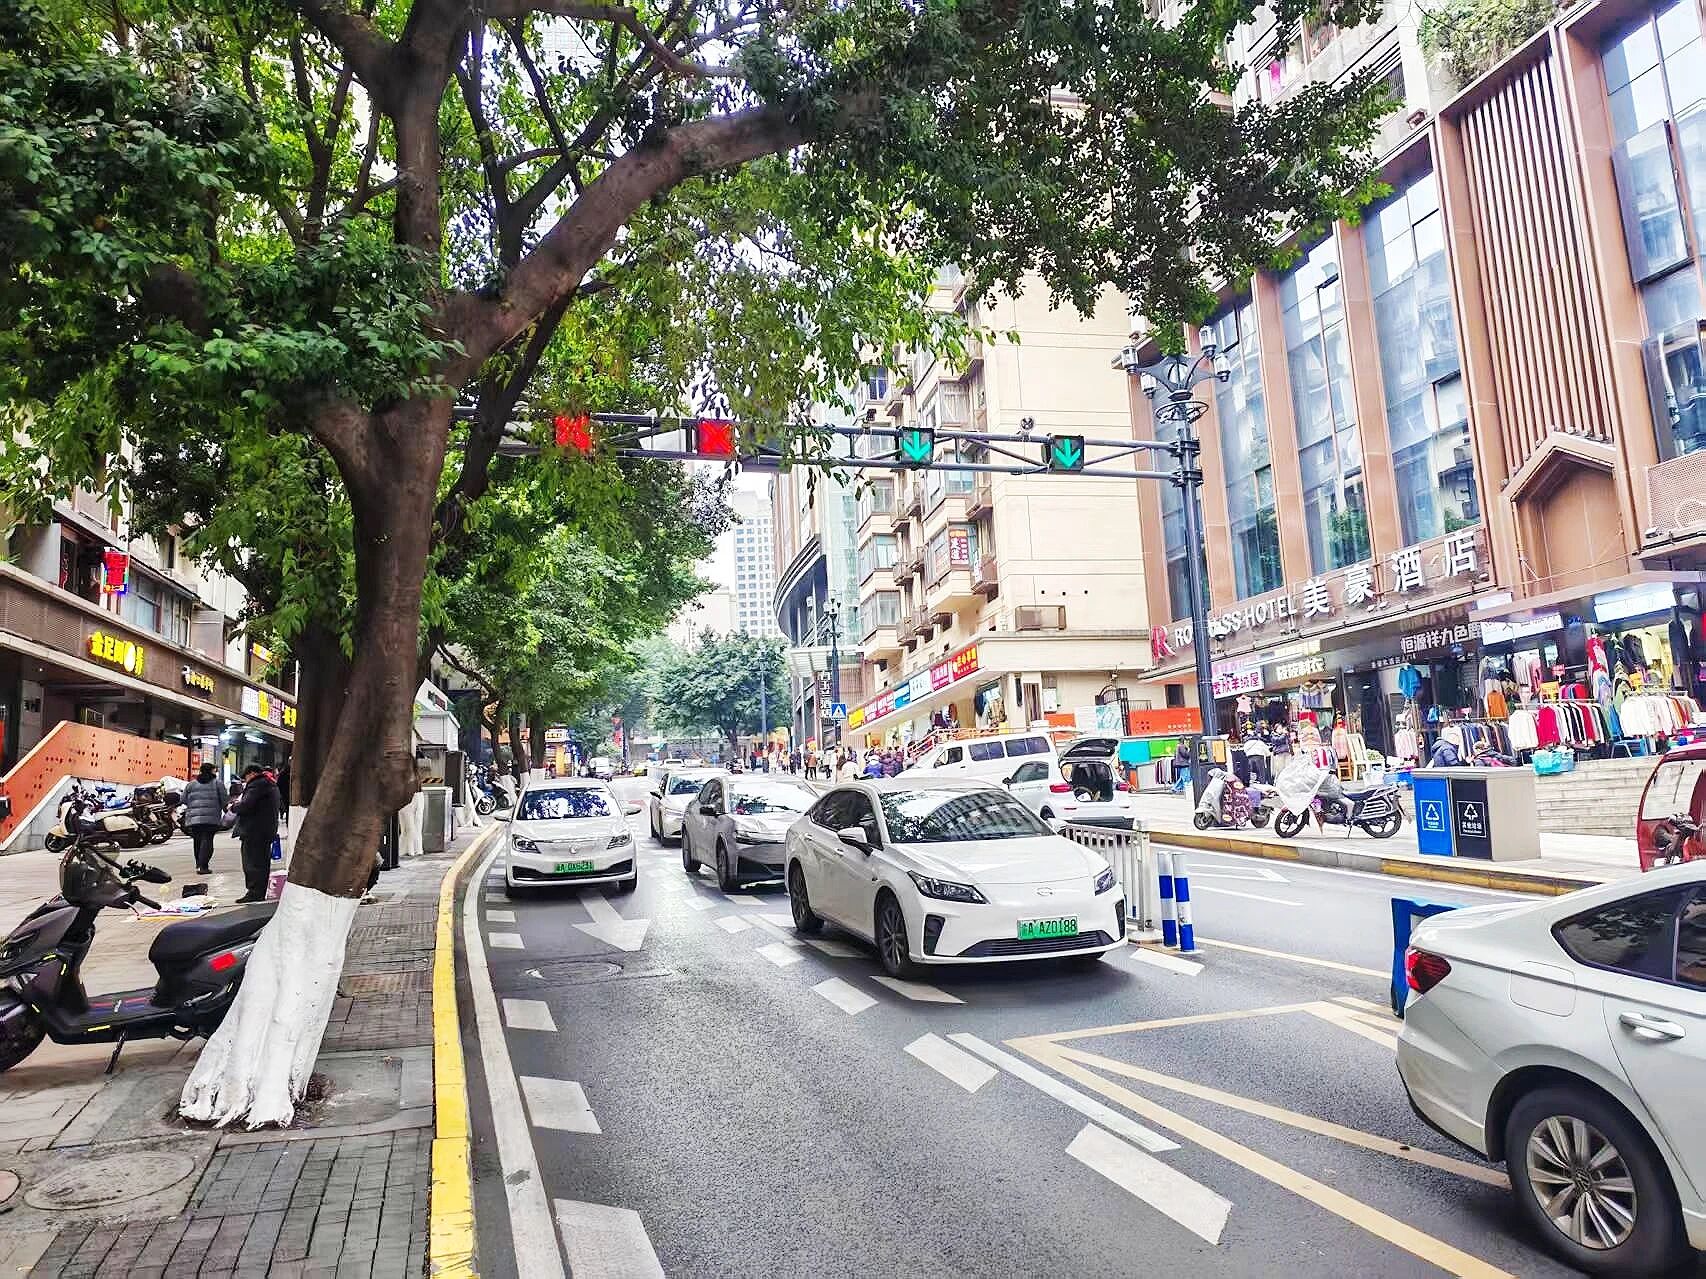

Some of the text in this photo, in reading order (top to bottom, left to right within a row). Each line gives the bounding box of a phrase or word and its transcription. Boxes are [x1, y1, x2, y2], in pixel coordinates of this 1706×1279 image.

[1302, 530, 1478, 618] 美豪酒店
[1245, 593, 1297, 628] HOTEL
[1401, 622, 1481, 654] 恒源祥九色鹿
